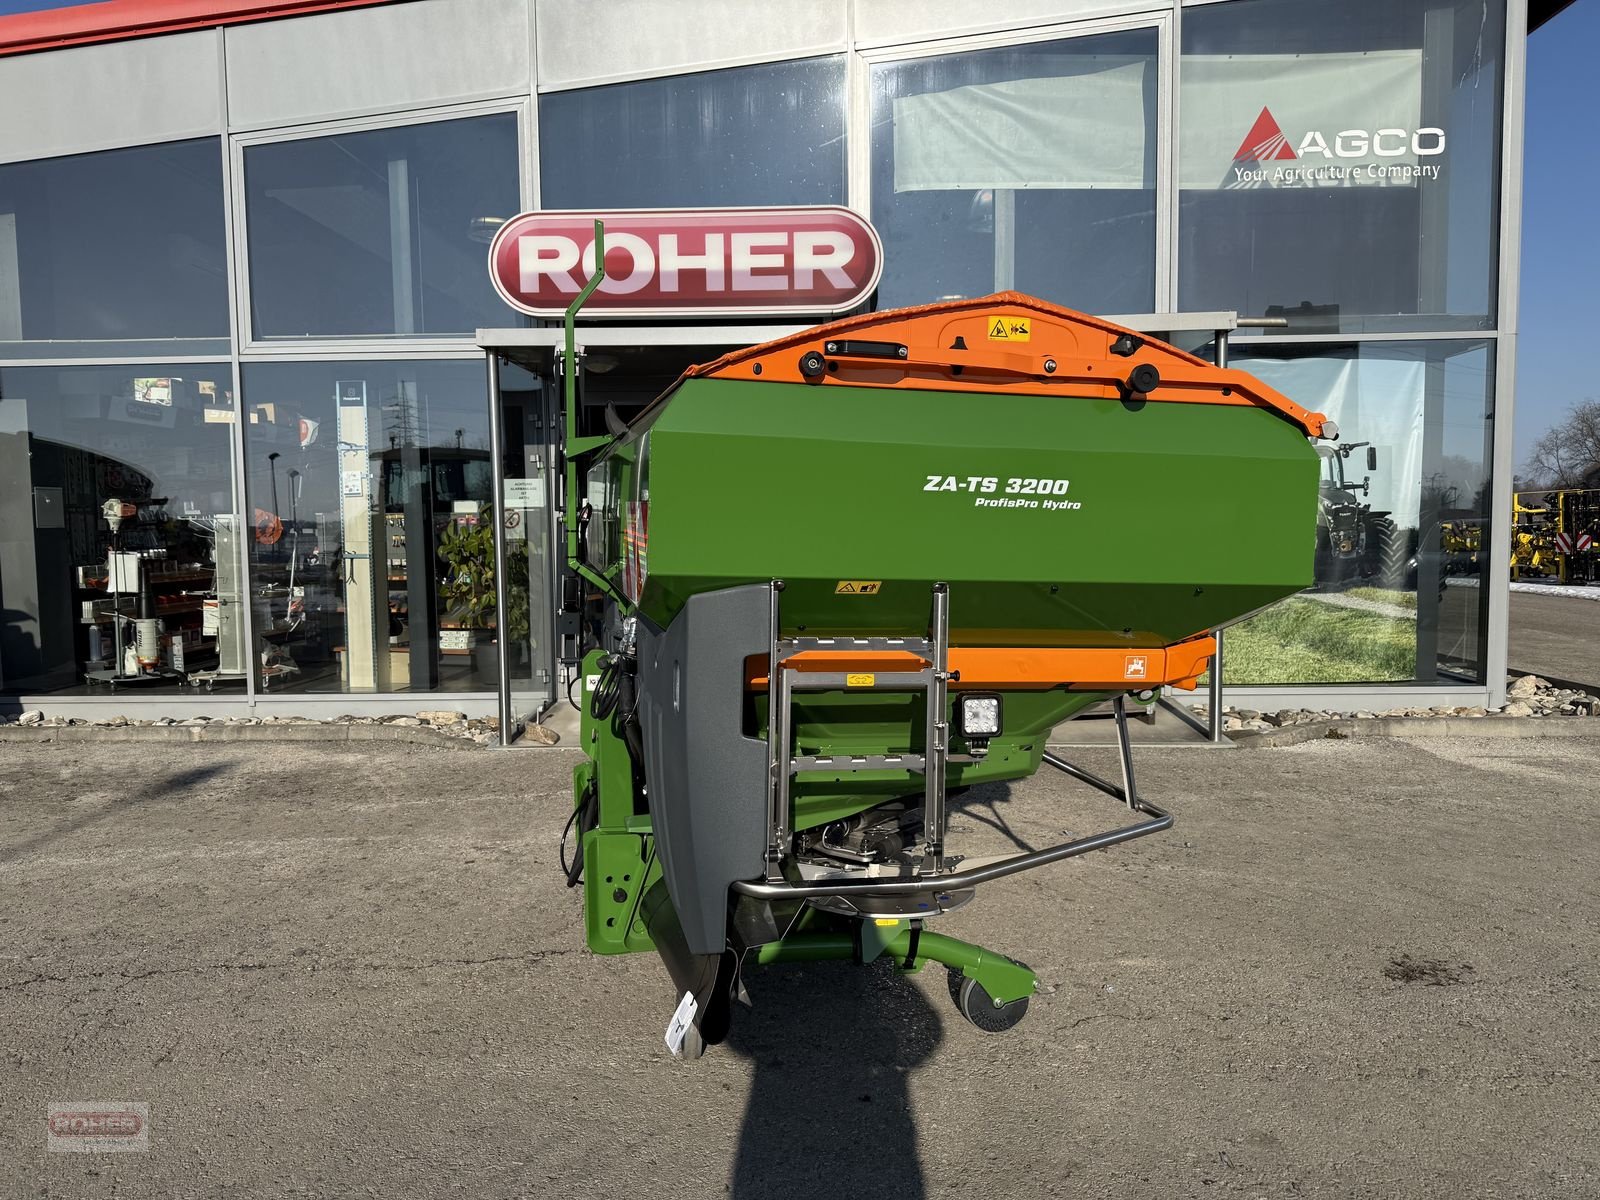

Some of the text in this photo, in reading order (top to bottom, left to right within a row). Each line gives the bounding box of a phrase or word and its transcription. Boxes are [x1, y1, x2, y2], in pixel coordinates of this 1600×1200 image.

[1297, 127, 1446, 159] AGCO
[1234, 163, 1441, 185] Your Agriculture Company
[518, 230, 858, 295] ROHER
[923, 475, 1070, 495] ZA-TS 3200
[975, 497, 1082, 511] ProfisPro Hydro
